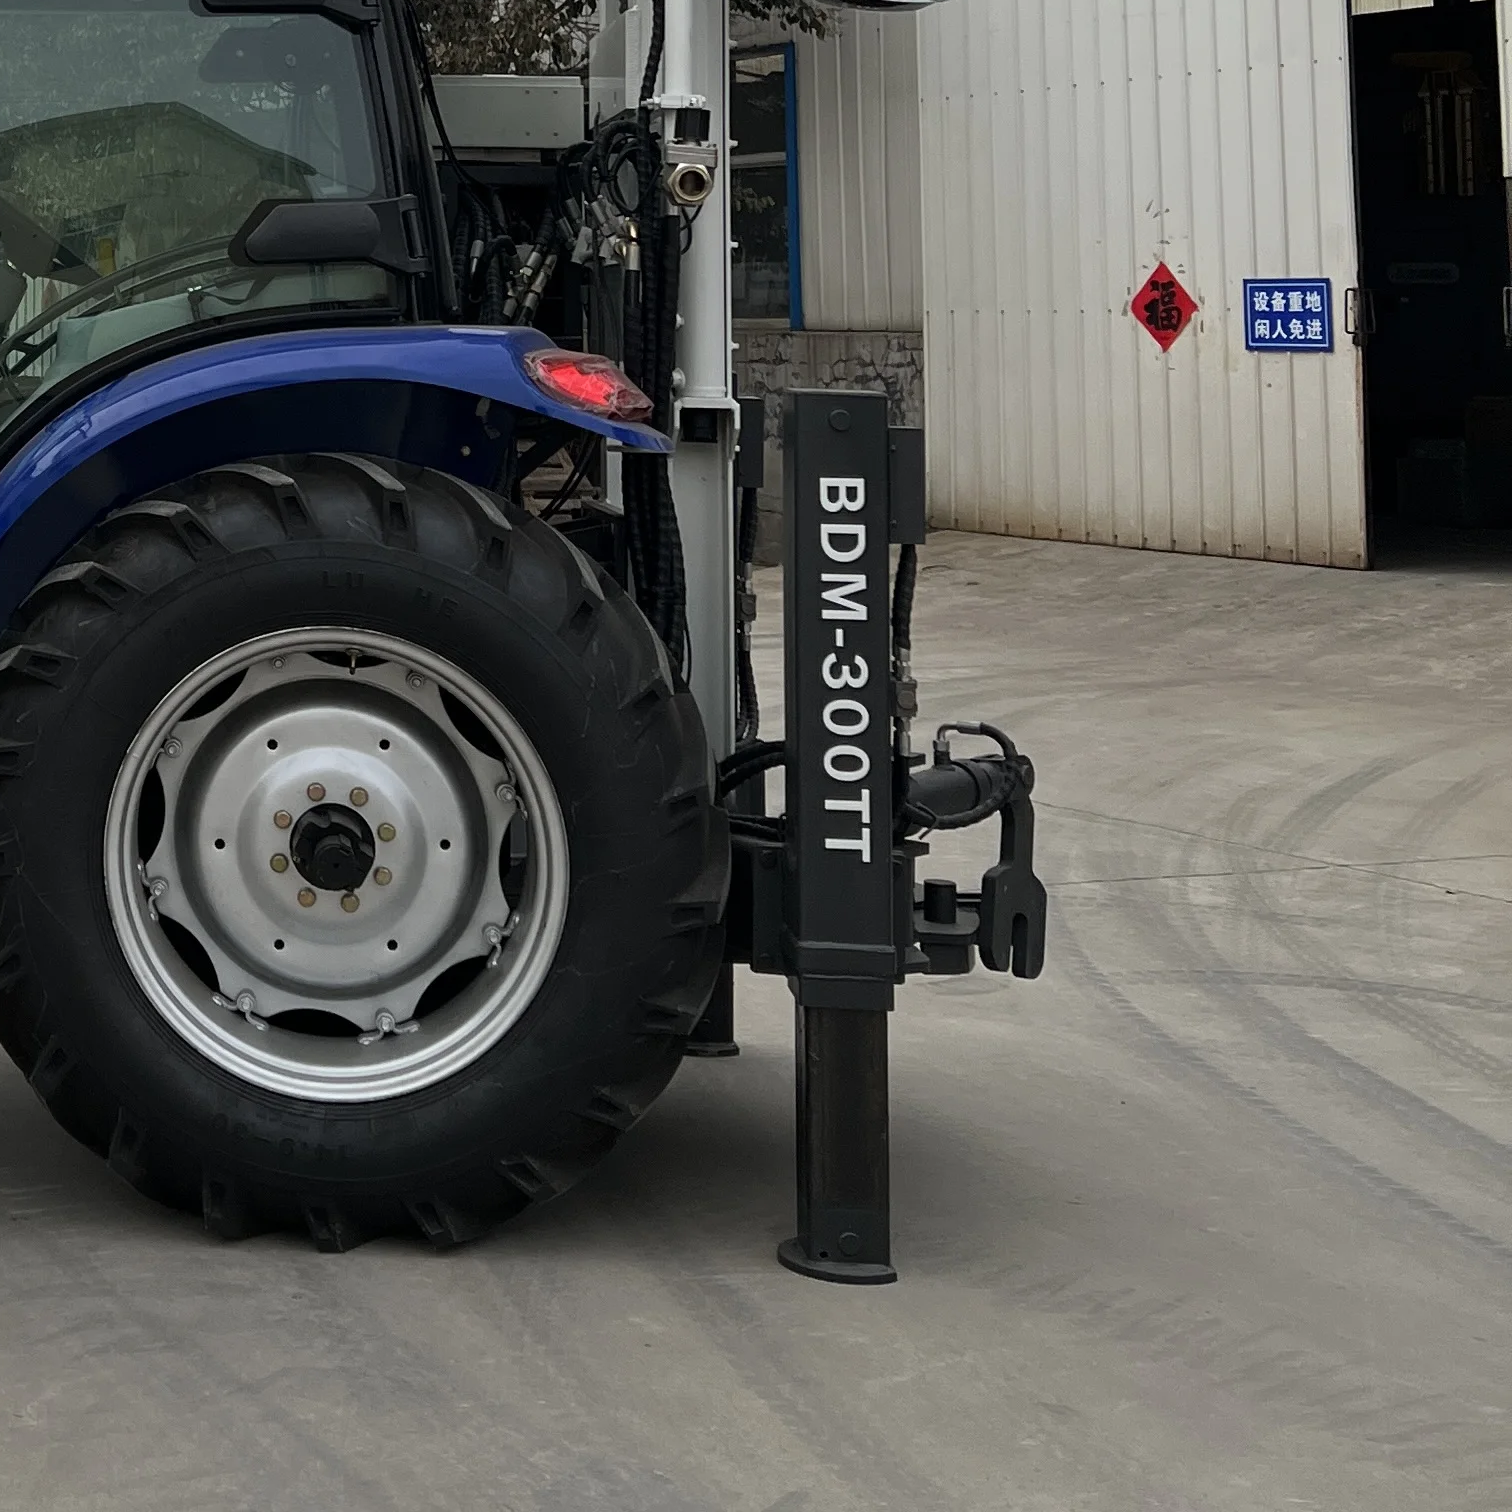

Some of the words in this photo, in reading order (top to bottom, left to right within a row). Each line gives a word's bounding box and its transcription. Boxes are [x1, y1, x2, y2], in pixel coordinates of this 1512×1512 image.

[1143, 279, 1183, 333] 福
[1253, 291, 1323, 313] 设备重地
[1254, 319, 1323, 340] 闲人免进
[818, 476, 872, 864] BDM-300TT
